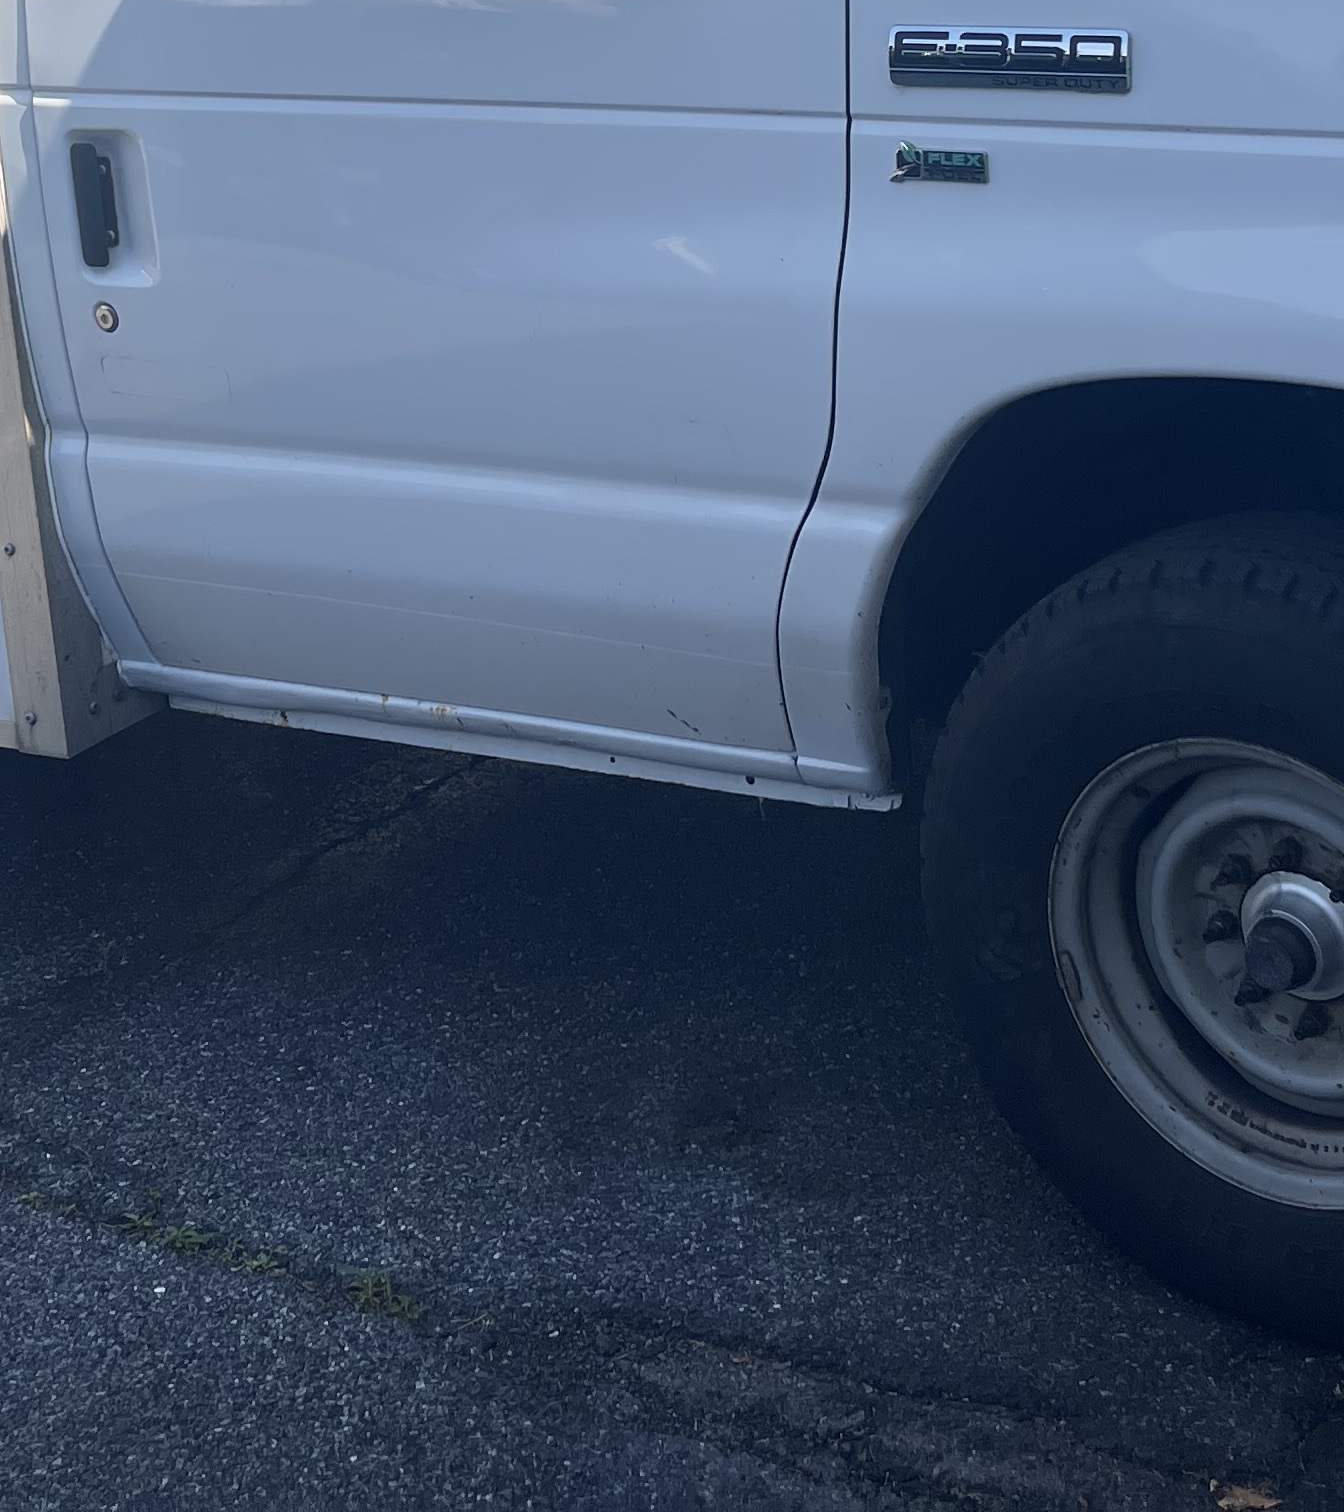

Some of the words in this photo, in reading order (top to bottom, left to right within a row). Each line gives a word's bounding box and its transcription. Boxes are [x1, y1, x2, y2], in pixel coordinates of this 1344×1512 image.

[894, 31, 1123, 70] E-350
[991, 76, 1059, 89] SUPER
[1063, 77, 1120, 91] DUTY
[927, 152, 983, 168] FLEX
